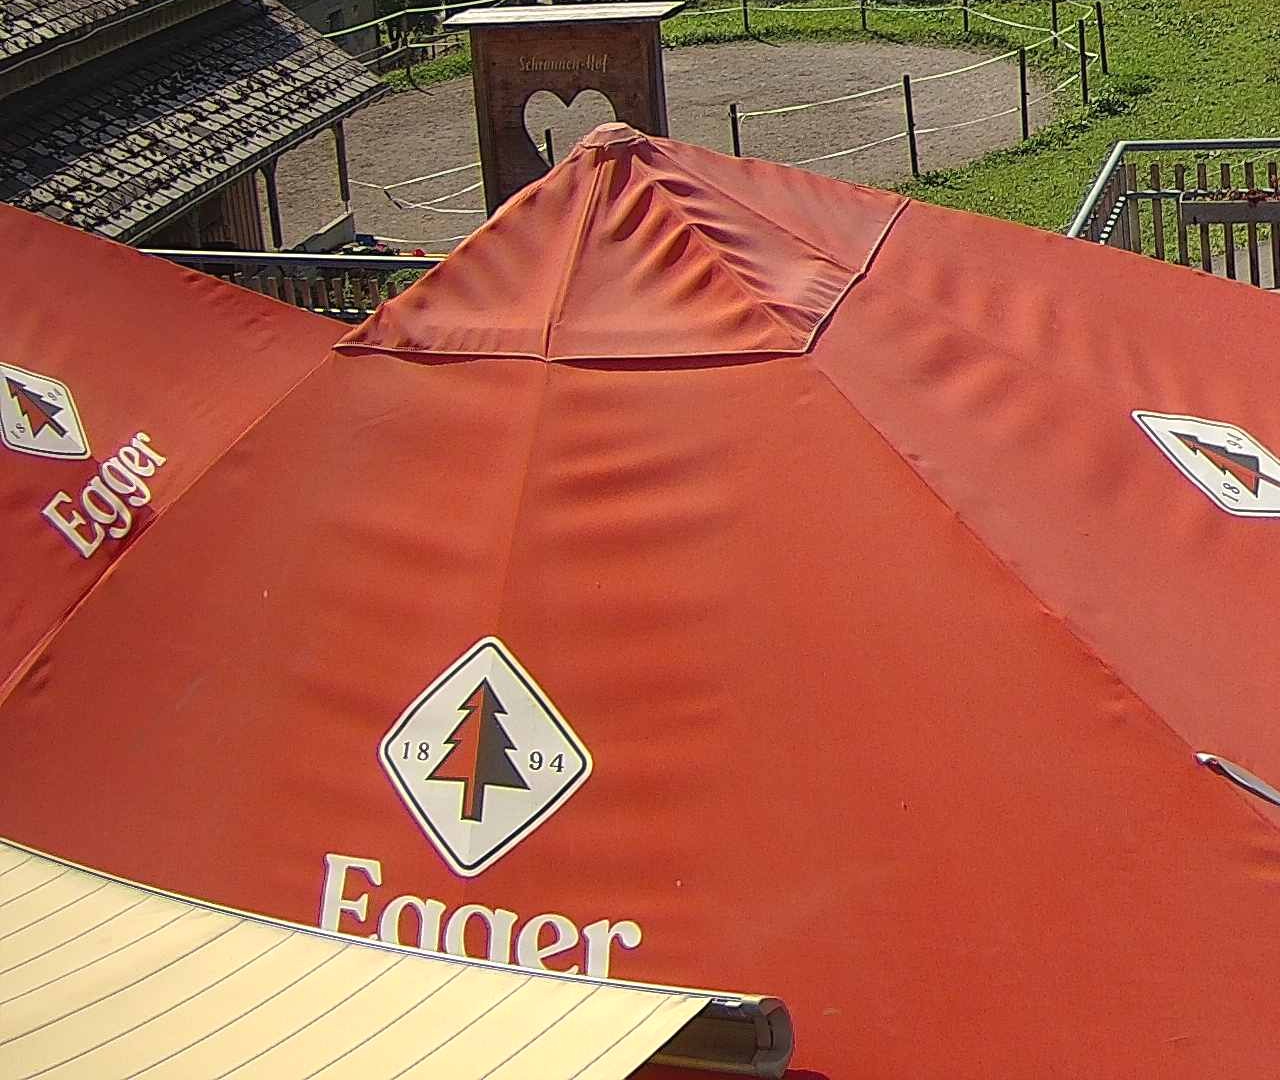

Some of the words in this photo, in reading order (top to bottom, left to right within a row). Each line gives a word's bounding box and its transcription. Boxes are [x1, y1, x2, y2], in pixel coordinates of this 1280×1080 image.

[42, 431, 168, 558] Egger
[402, 741, 431, 761] 18
[528, 751, 565, 773] 94
